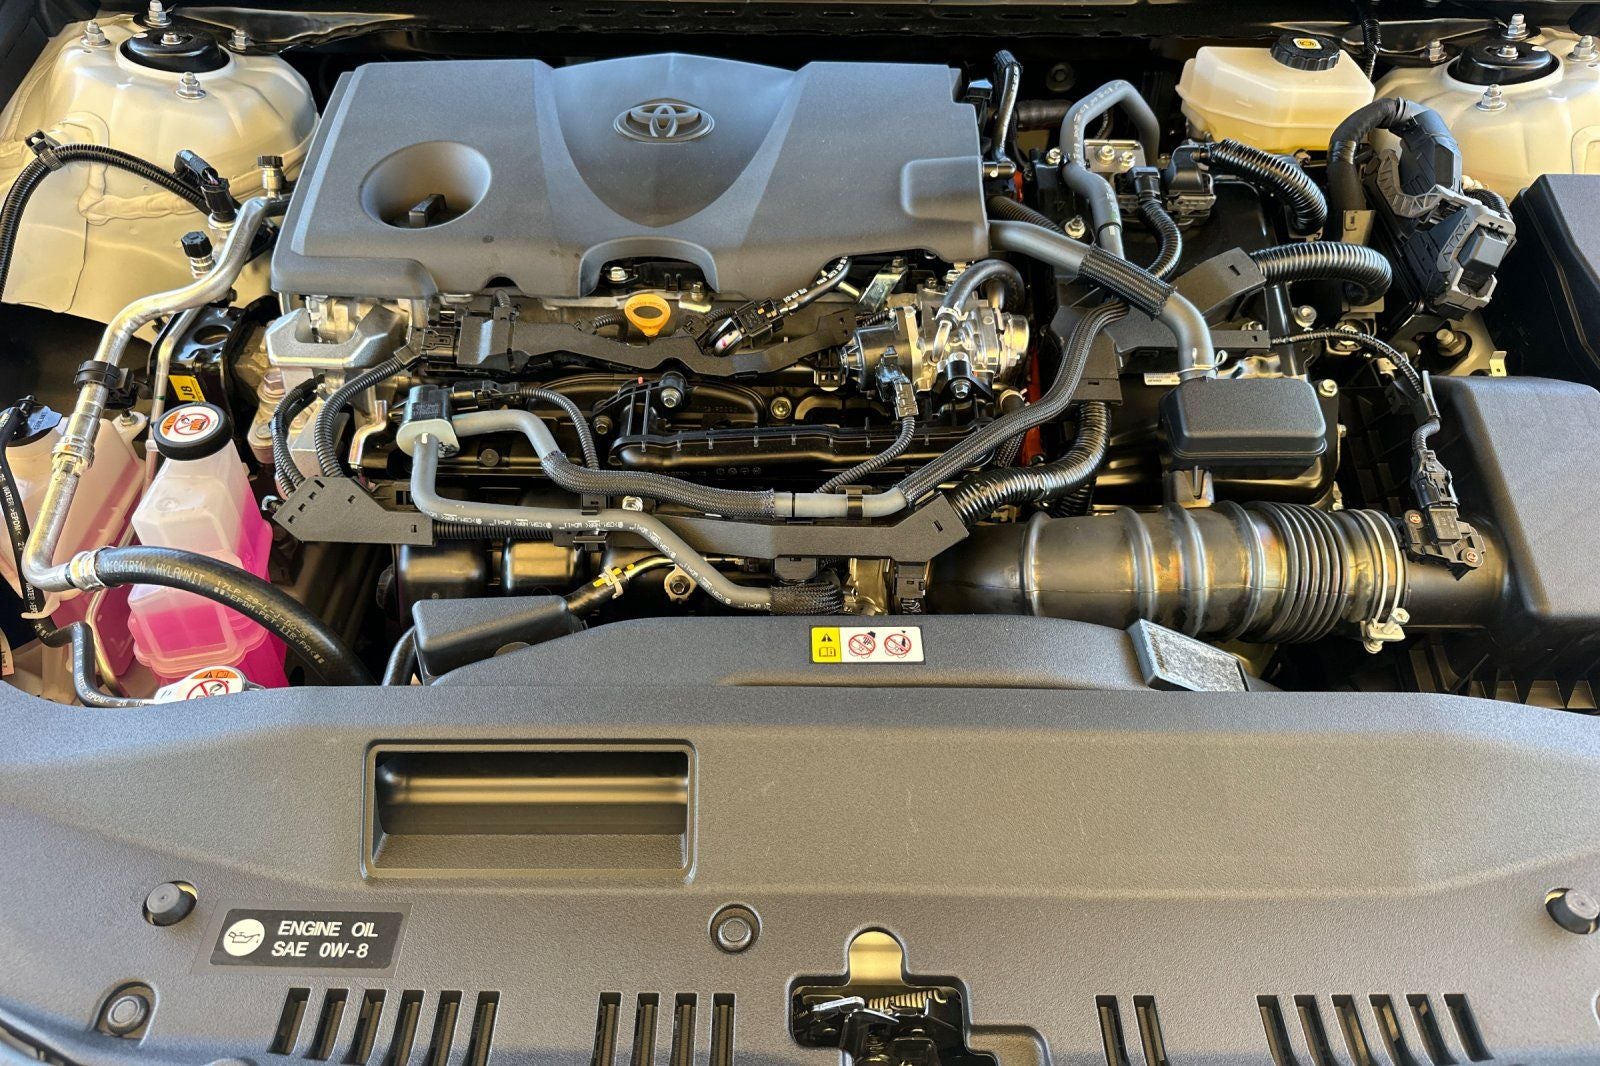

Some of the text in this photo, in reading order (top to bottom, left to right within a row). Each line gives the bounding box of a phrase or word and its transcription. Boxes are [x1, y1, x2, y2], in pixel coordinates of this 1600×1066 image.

[3, 486, 14, 506] WATER
[278, 921, 378, 937] ENGINE OIL
[271, 941, 369, 958] SAE 0W-8
